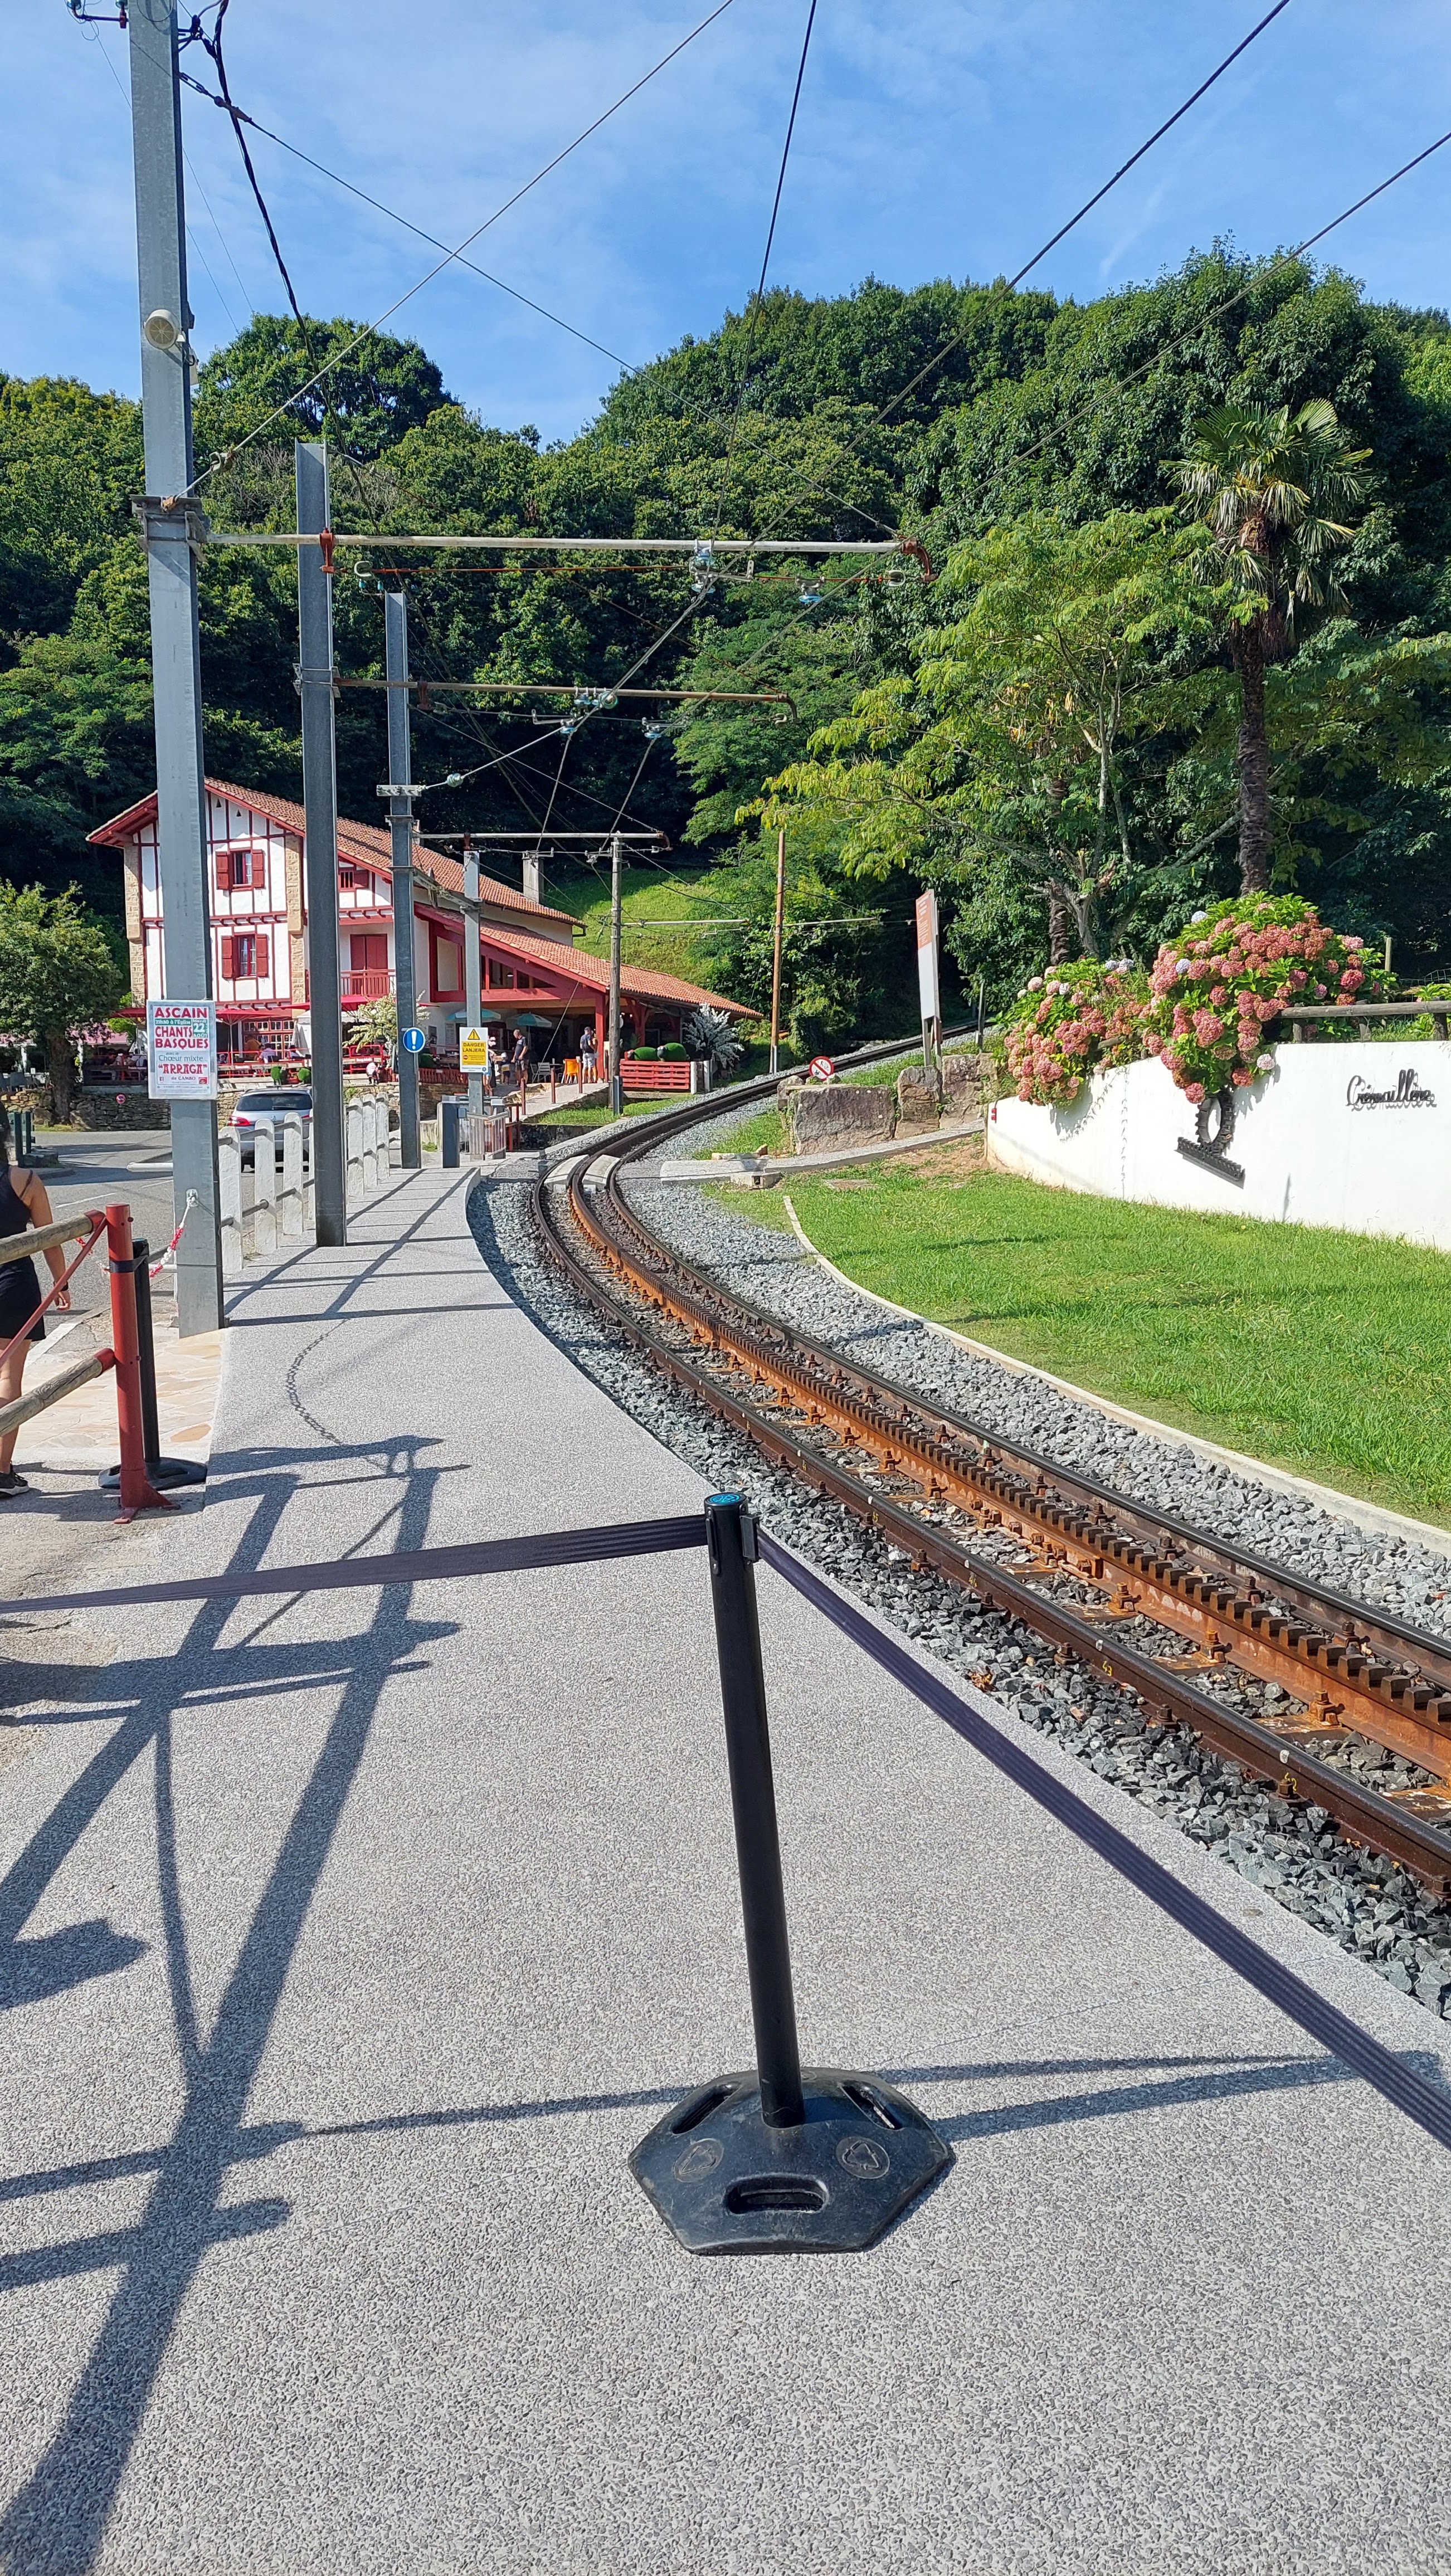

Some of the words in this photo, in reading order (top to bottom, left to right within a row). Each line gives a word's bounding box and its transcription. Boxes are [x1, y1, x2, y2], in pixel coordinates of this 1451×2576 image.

[154, 1007, 207, 1018] ASCAIN
[155, 1026, 193, 1038] CHANTS
[193, 1023, 205, 1033] 22
[155, 1038, 208, 1050] BASQUES
